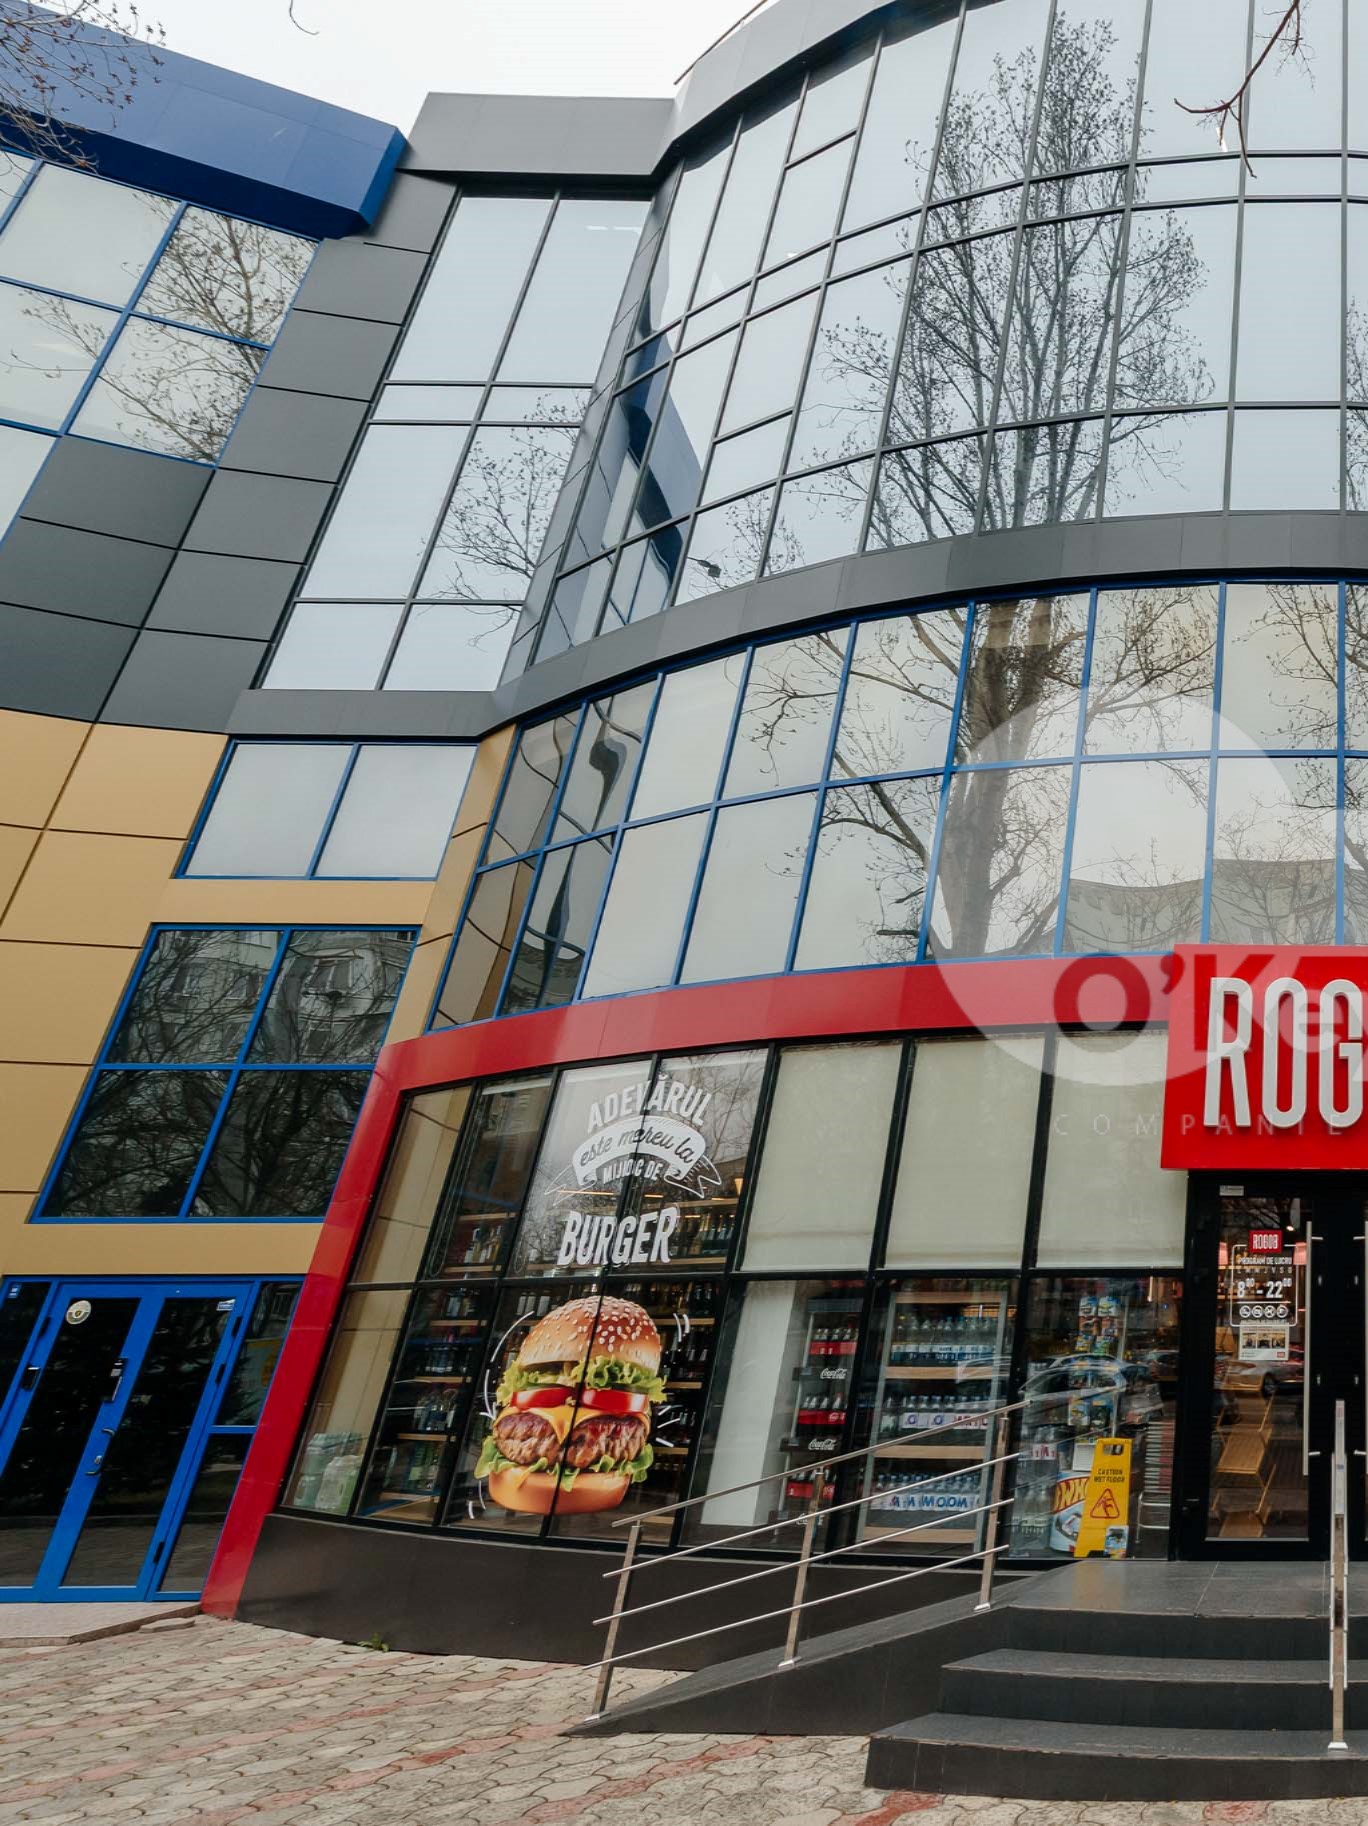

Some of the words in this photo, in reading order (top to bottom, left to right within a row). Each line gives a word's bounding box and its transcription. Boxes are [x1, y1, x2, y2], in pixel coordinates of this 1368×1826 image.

[588, 1072, 712, 1135] ADEVĂRUL
[580, 1136, 614, 1167] este
[616, 1126, 674, 1150] mereu
[674, 1137, 696, 1164] la
[643, 1160, 664, 1181] DE
[557, 1204, 679, 1268] BURGER
[1097, 1467, 1123, 1476] CAUTION
